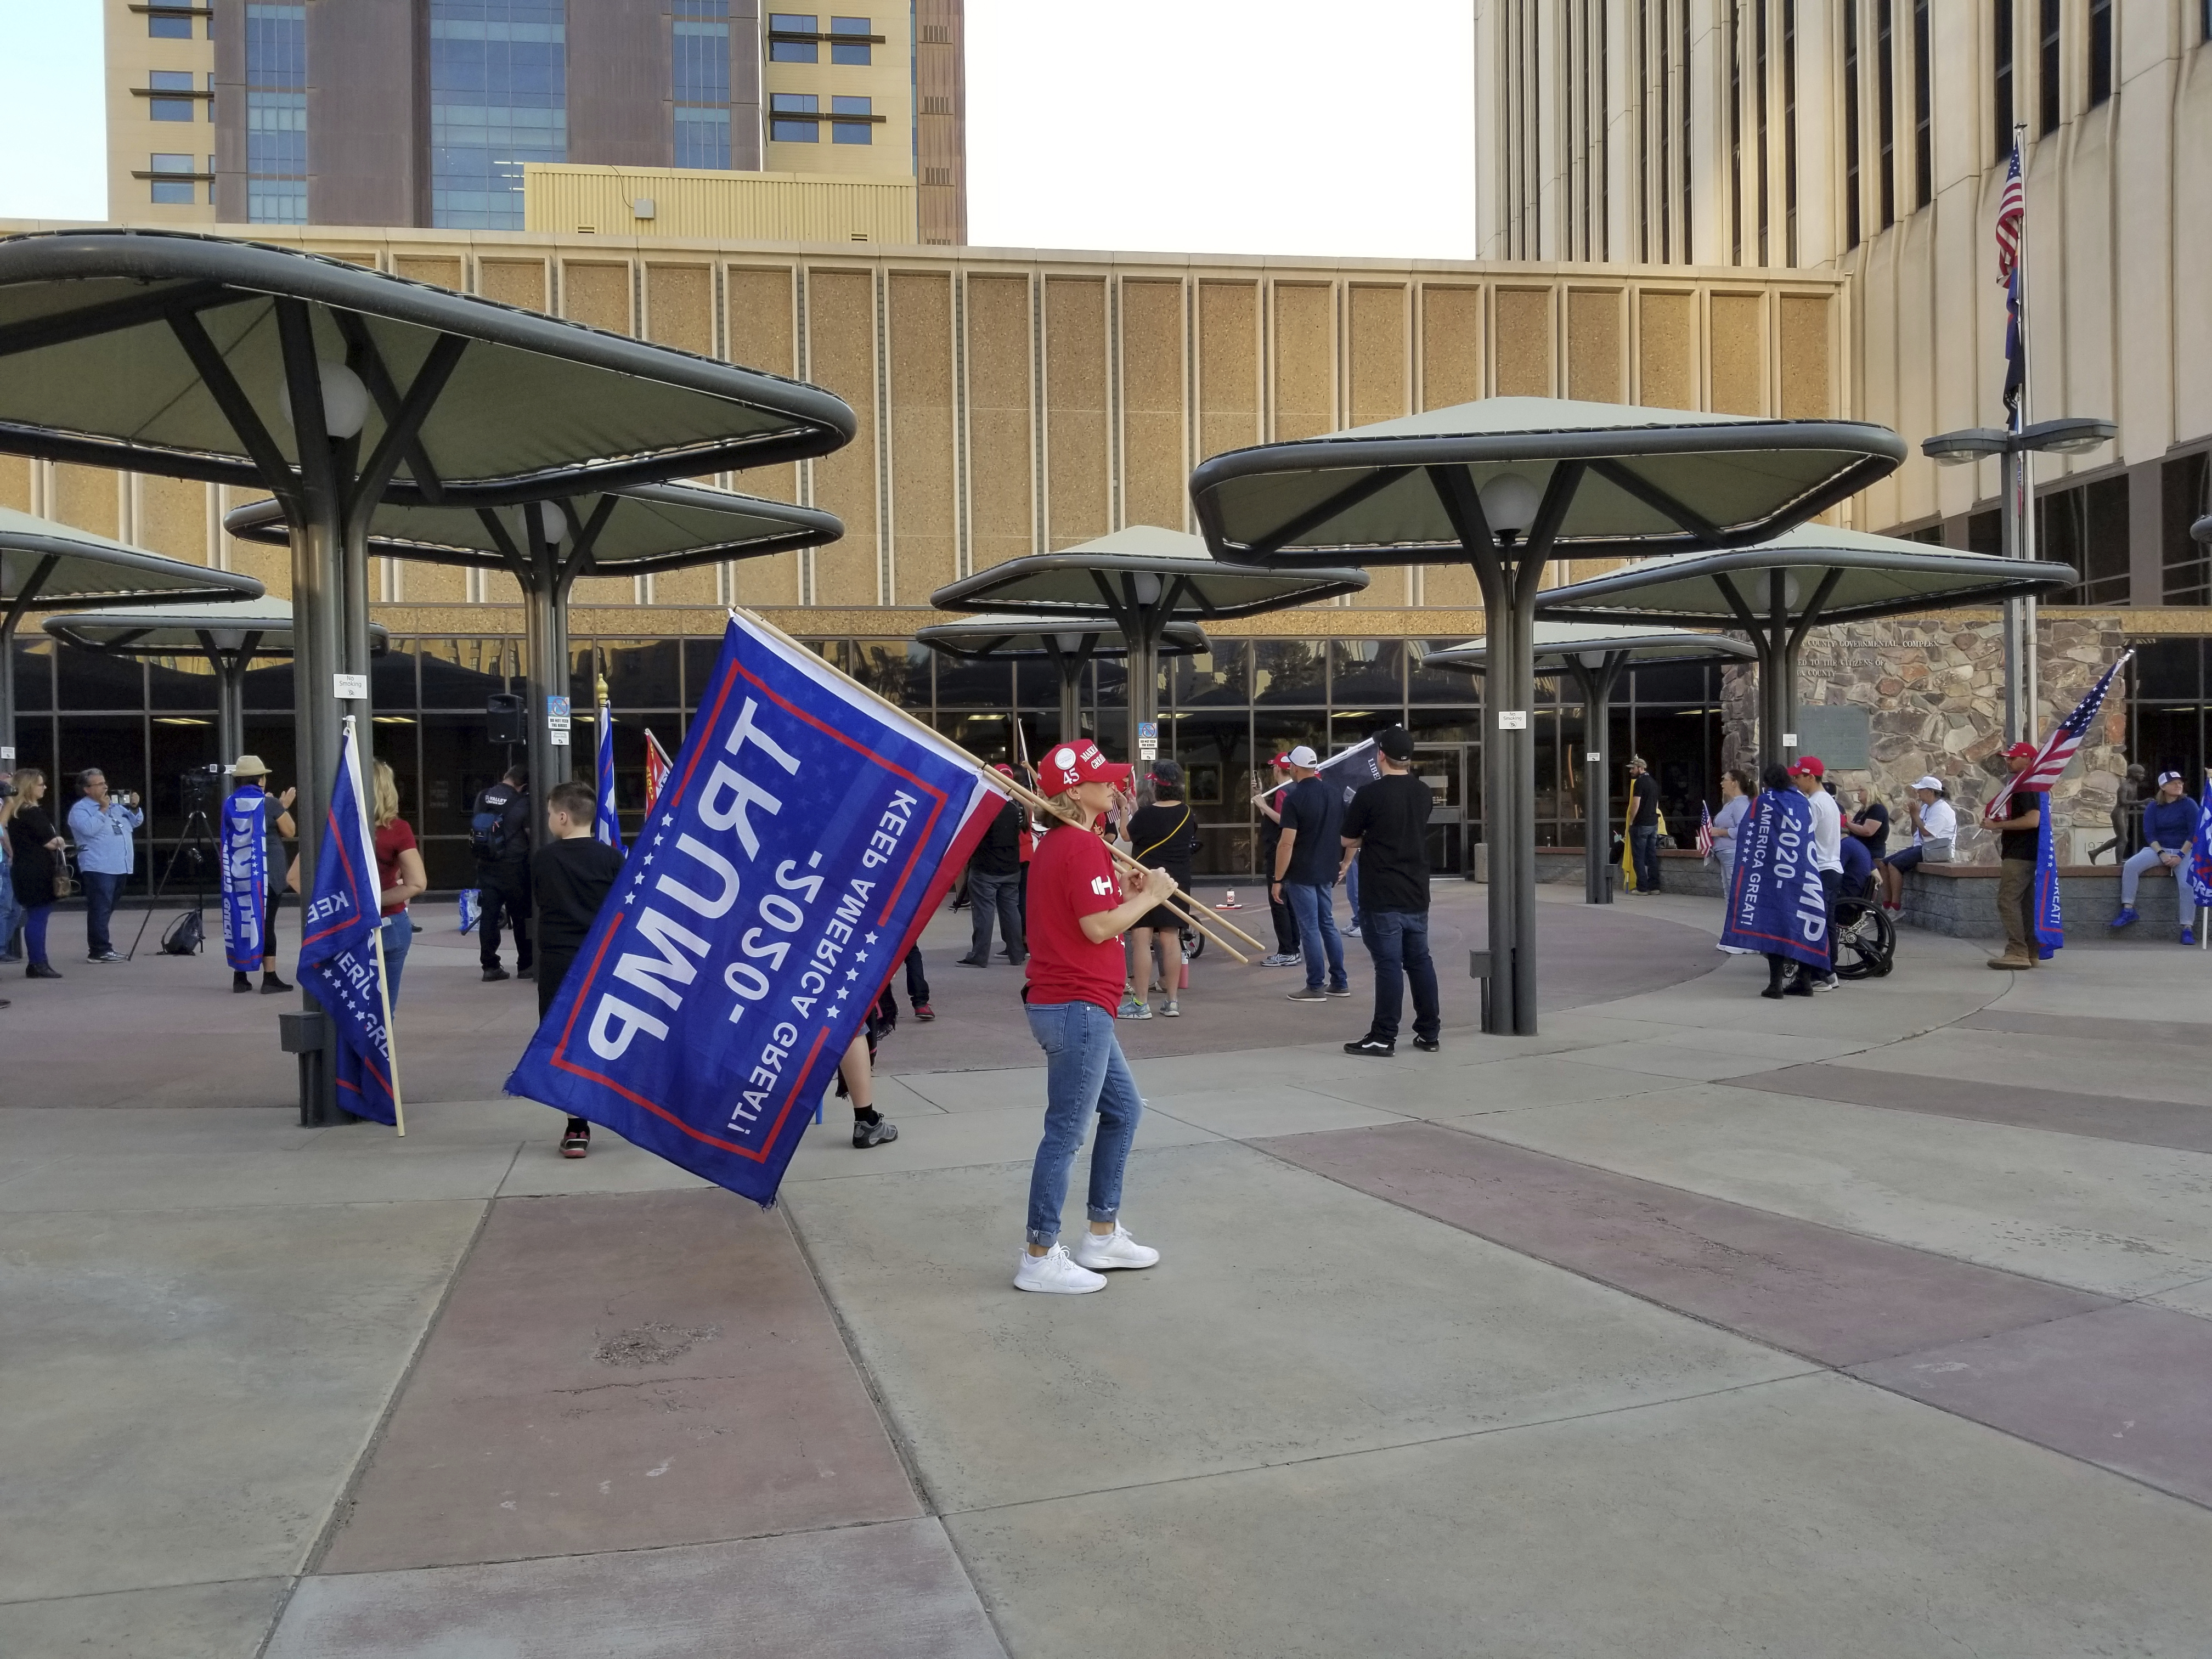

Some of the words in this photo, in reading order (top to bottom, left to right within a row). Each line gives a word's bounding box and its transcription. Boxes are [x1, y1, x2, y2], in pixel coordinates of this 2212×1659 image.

[1063, 768, 1080, 785] 45
[1752, 803, 1774, 868] AMERICA
[1773, 808, 1802, 889] -2020-
[1740, 873, 1761, 926] GREAT!
